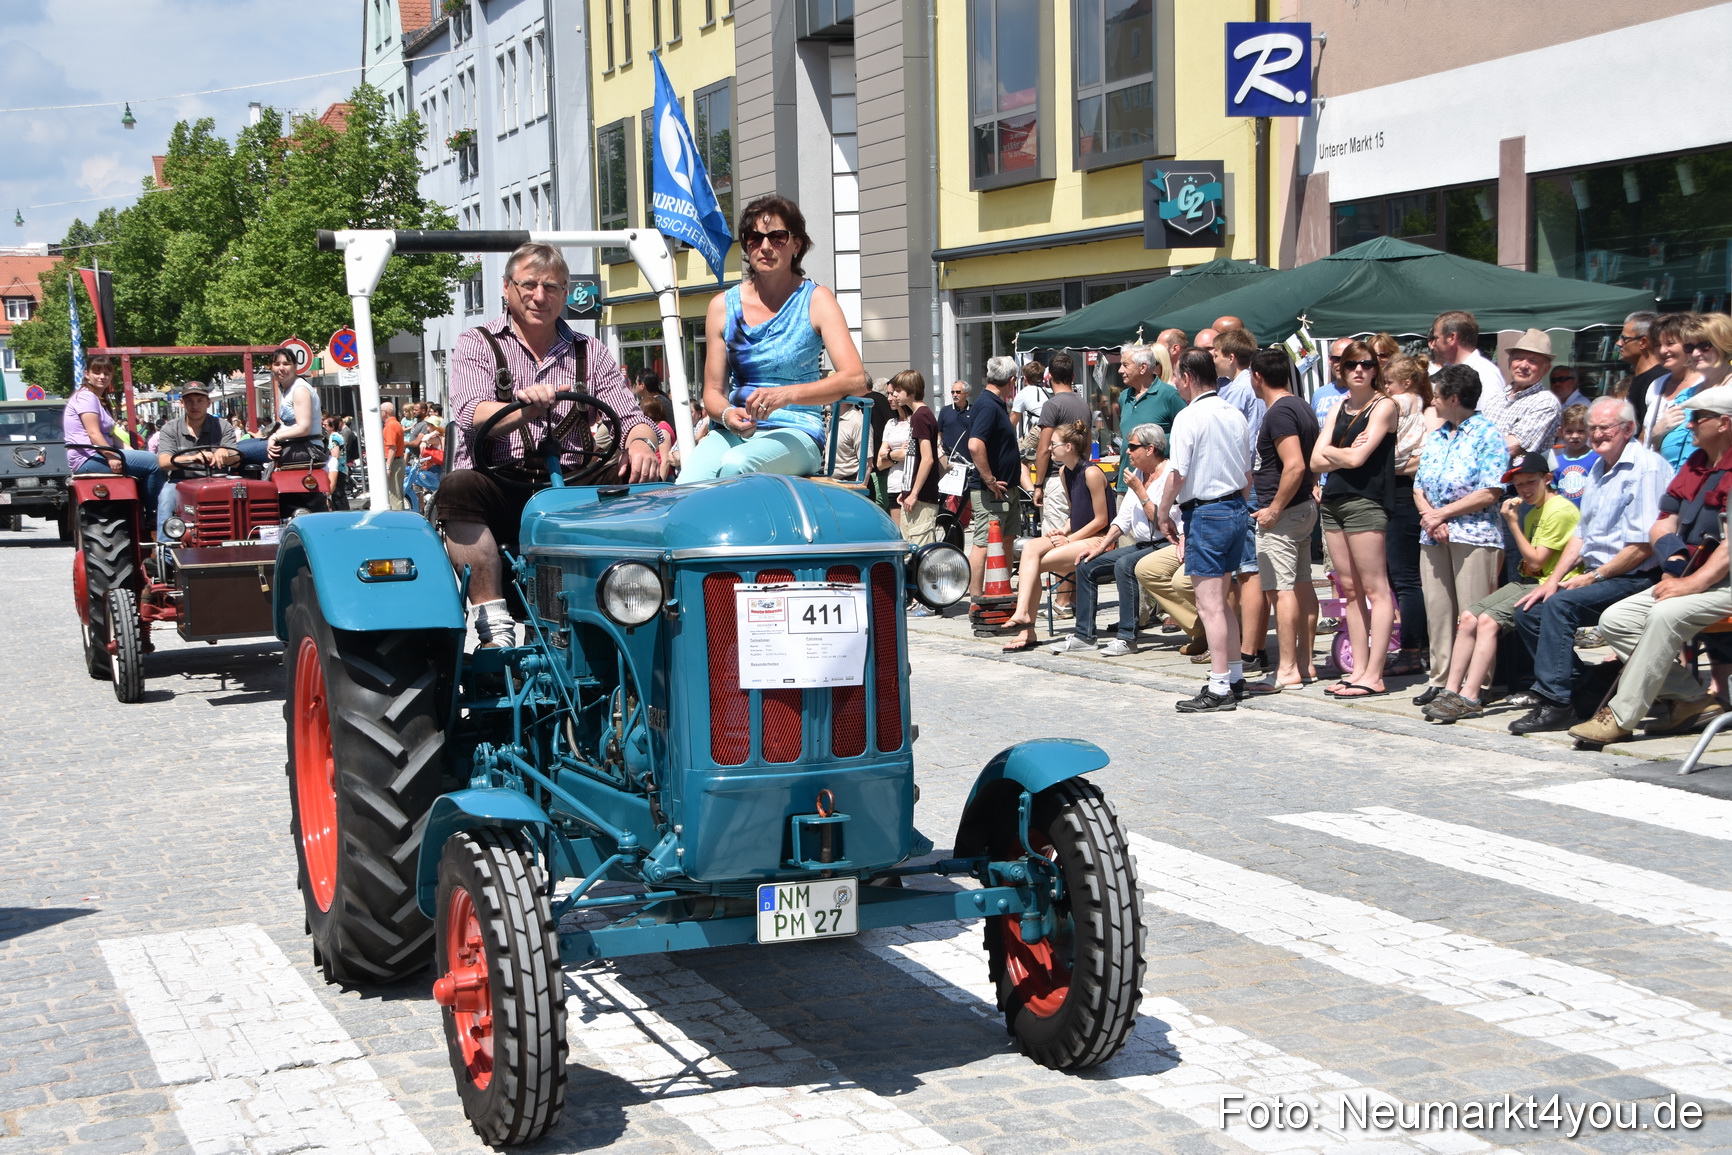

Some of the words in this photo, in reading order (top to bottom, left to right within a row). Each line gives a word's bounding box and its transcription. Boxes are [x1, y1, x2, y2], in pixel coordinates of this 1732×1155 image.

[1319, 142, 1347, 159] Unterer
[1349, 135, 1372, 154] Markt
[1374, 131, 1384, 149] 15
[1177, 184, 1205, 220] G2
[573, 286, 588, 306] G2
[802, 604, 842, 625] 411
[764, 902, 771, 910] D
[779, 885, 810, 911] NM
[774, 912, 805, 938] PM
[814, 909, 842, 933] 27
